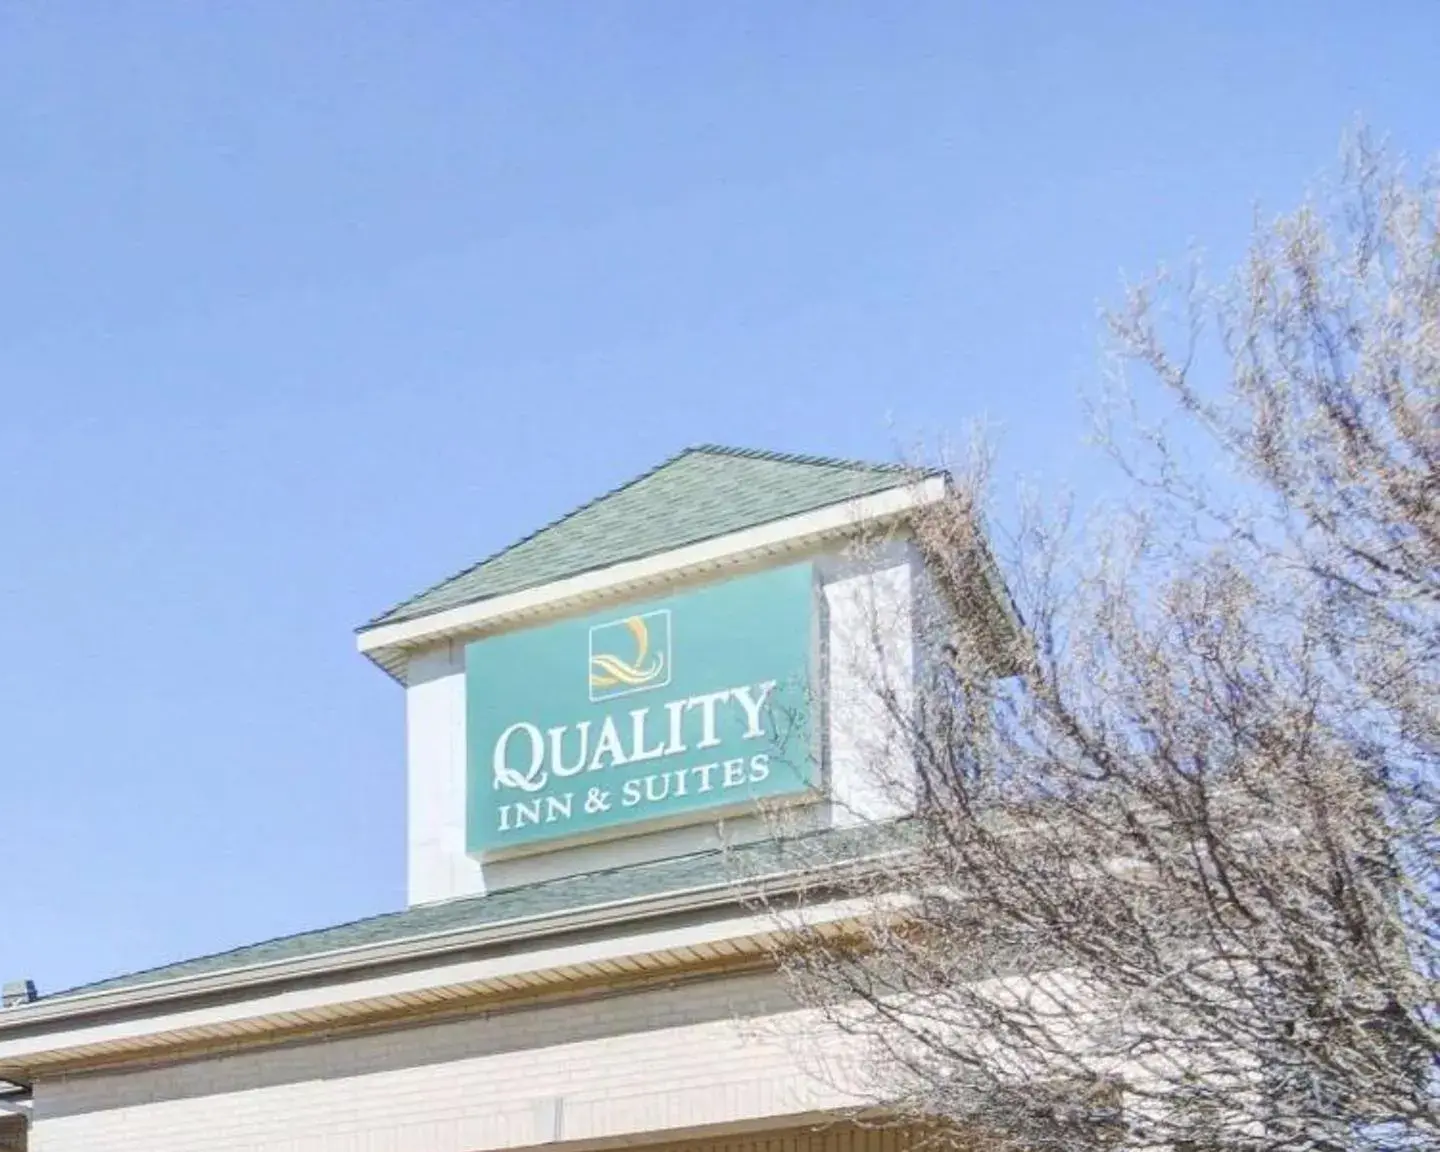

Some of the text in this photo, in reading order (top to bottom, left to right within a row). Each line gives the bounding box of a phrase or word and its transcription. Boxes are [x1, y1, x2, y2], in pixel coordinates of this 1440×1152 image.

[493, 680, 777, 792] QUALITY
[498, 753, 771, 831] INN & SUITES
